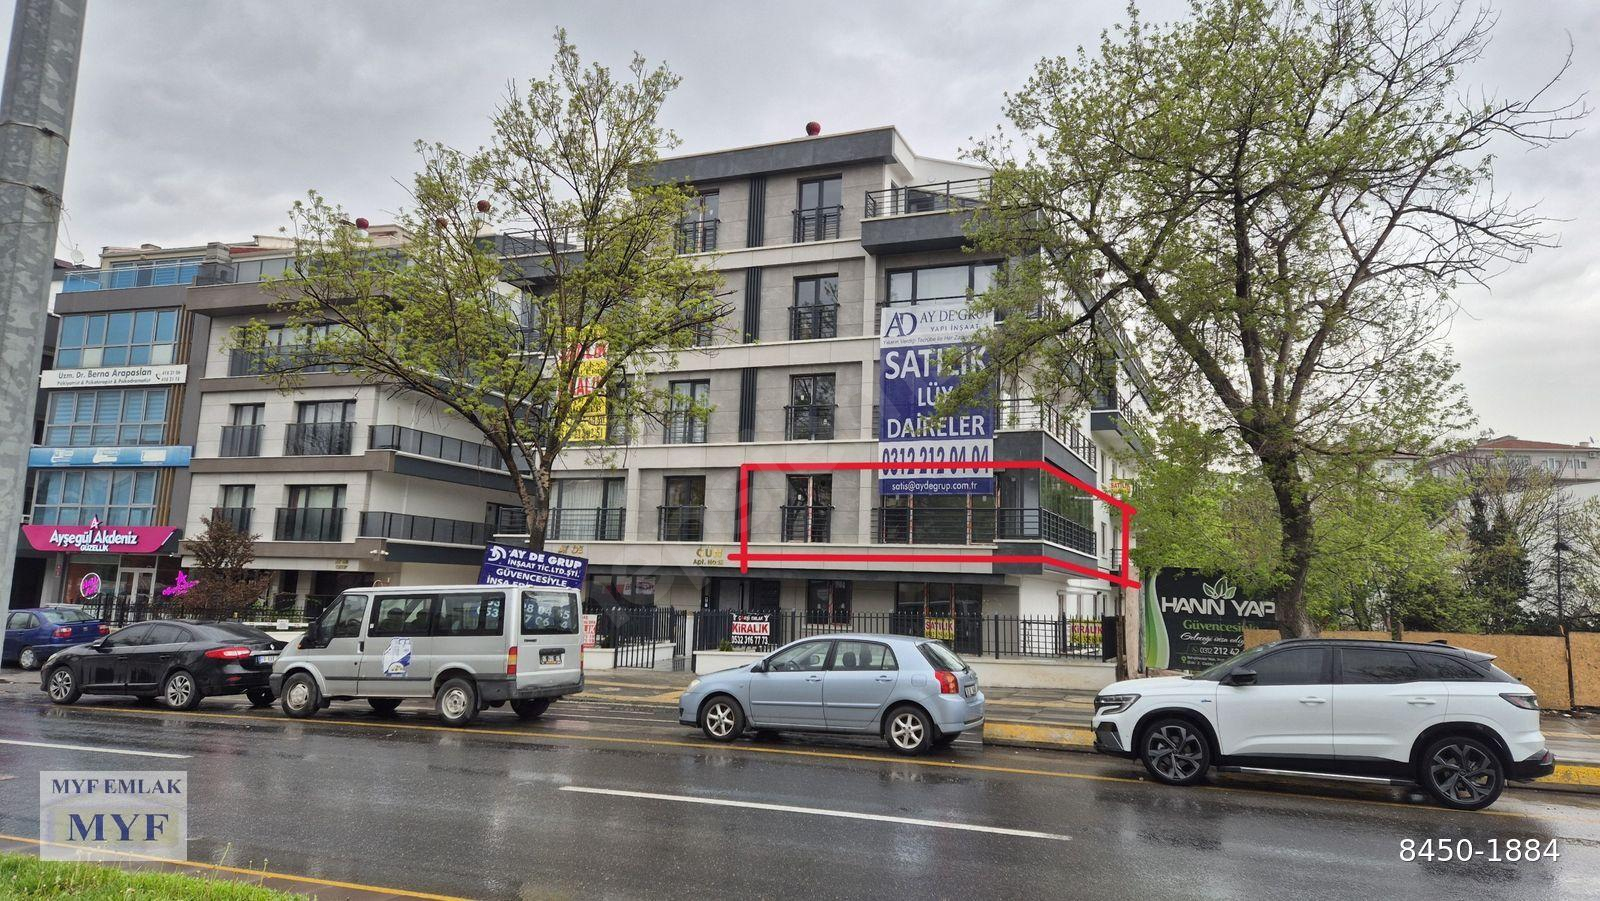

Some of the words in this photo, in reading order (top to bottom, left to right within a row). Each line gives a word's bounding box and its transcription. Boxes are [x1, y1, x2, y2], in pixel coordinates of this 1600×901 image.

[920, 311, 936, 323] AY
[76, 371, 86, 379] Dr.
[88, 370, 110, 378] Berna
[887, 413, 985, 439] DAİRELER
[882, 447, 915, 475] 0312
[920, 446, 945, 475] 212
[950, 446, 966, 475] 04
[971, 444, 989, 475] 04
[892, 480, 978, 492] satis@aydegrup.com.tr
[49, 529, 93, 547] Ayşegül
[93, 530, 138, 545] Akdeniz
[507, 558, 536, 570] İNŞAAT
[510, 549, 526, 559] AY
[529, 552, 545, 563] DE
[548, 556, 582, 570] GRUP
[496, 567, 567, 587] GÜVENCESİYLE
[1161, 597, 1225, 616] HANN
[926, 621, 953, 630] SATILIK
[1183, 619, 1259, 632] Güvencesil
[1213, 646, 1228, 655] 212
